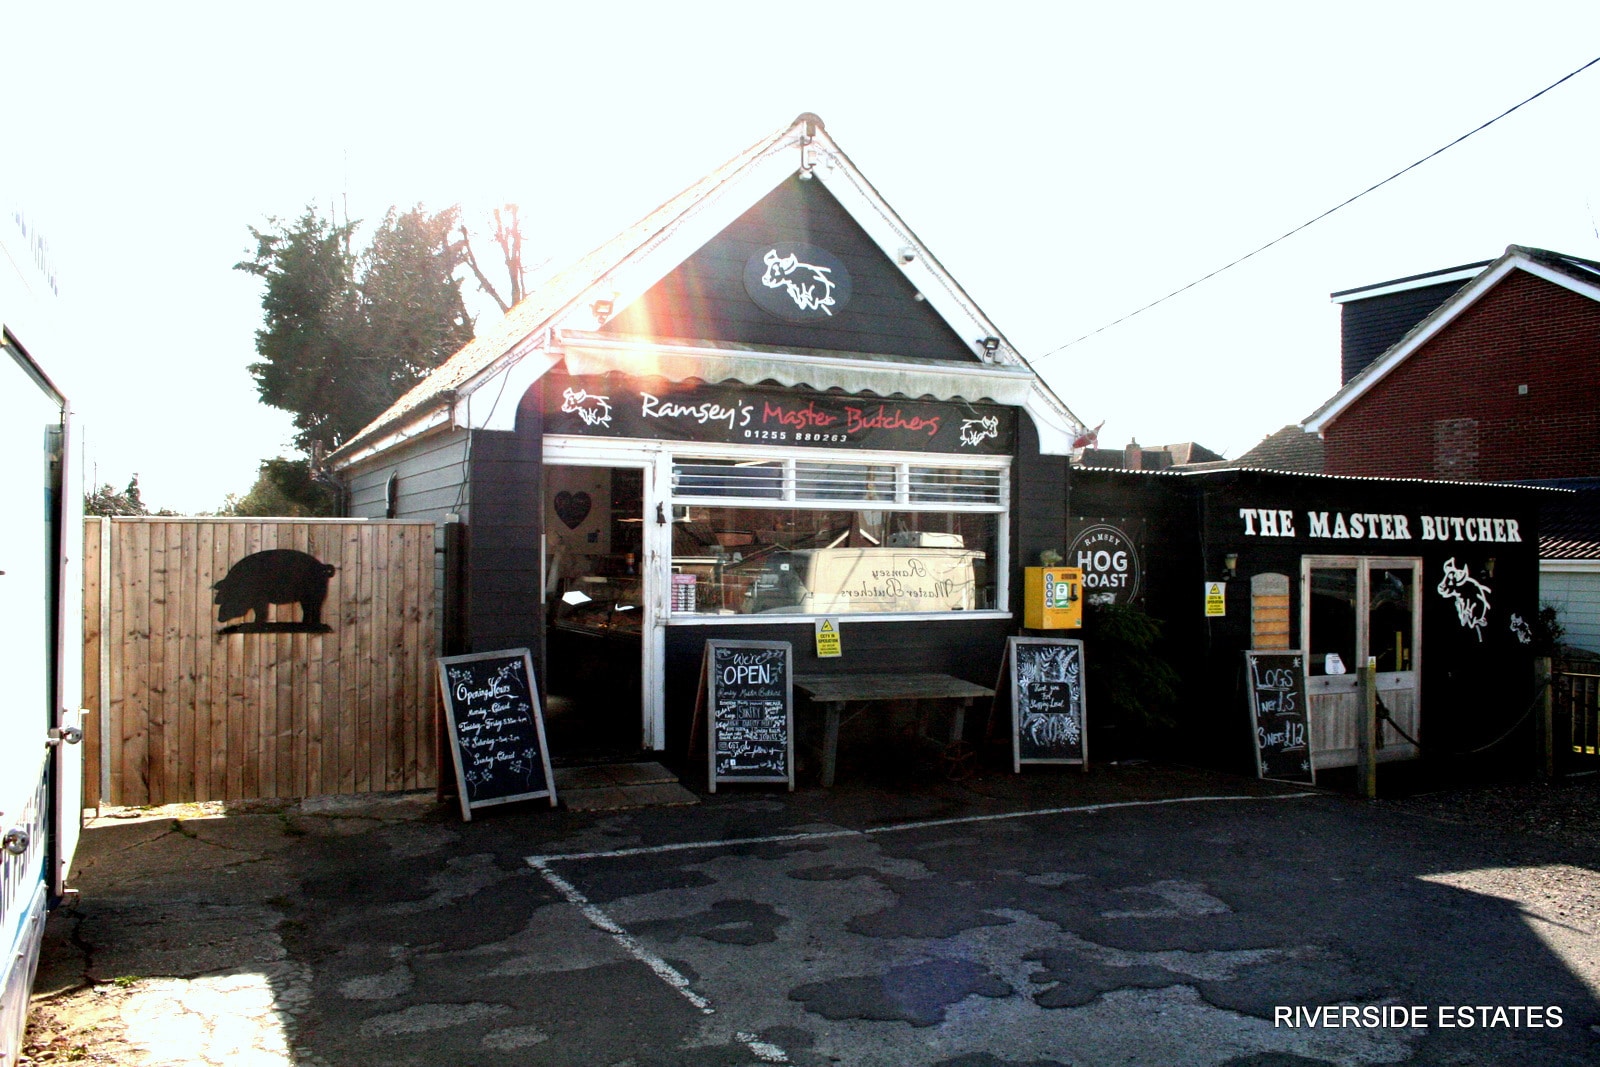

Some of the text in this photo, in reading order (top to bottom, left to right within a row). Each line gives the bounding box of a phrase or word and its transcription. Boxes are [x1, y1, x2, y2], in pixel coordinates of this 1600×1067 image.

[640, 392, 941, 436] Ramsey's Master Butchers
[744, 429, 848, 443] 01255 880263
[1239, 508, 1522, 543] THE MASTER BUTCHER
[1084, 533, 1120, 546] RAMSEY
[1077, 550, 1128, 572] HOG
[723, 664, 770, 685] OPEN
[1253, 665, 1294, 688] LOGS
[456, 683, 489, 705] Opening
